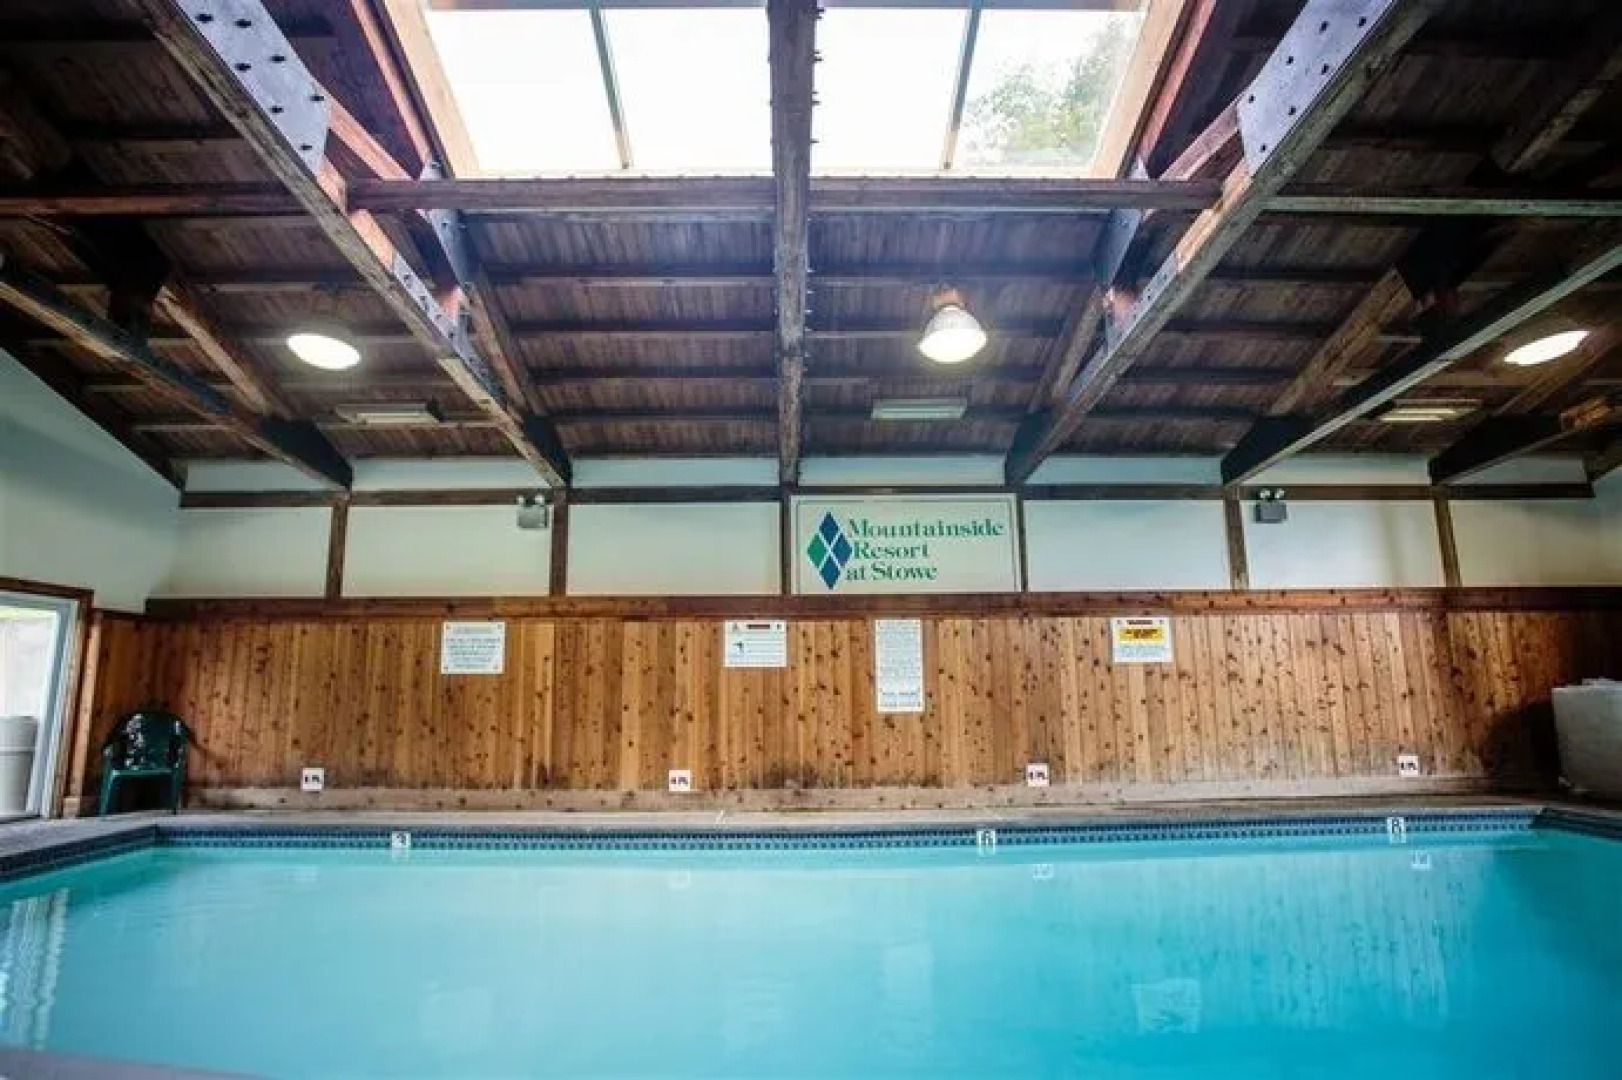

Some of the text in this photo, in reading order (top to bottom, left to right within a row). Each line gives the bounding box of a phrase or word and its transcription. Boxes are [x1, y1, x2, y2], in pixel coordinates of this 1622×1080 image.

[849, 518, 1004, 537] Mountainside
[853, 541, 929, 559] Resort
[846, 562, 938, 580] at Stowe
